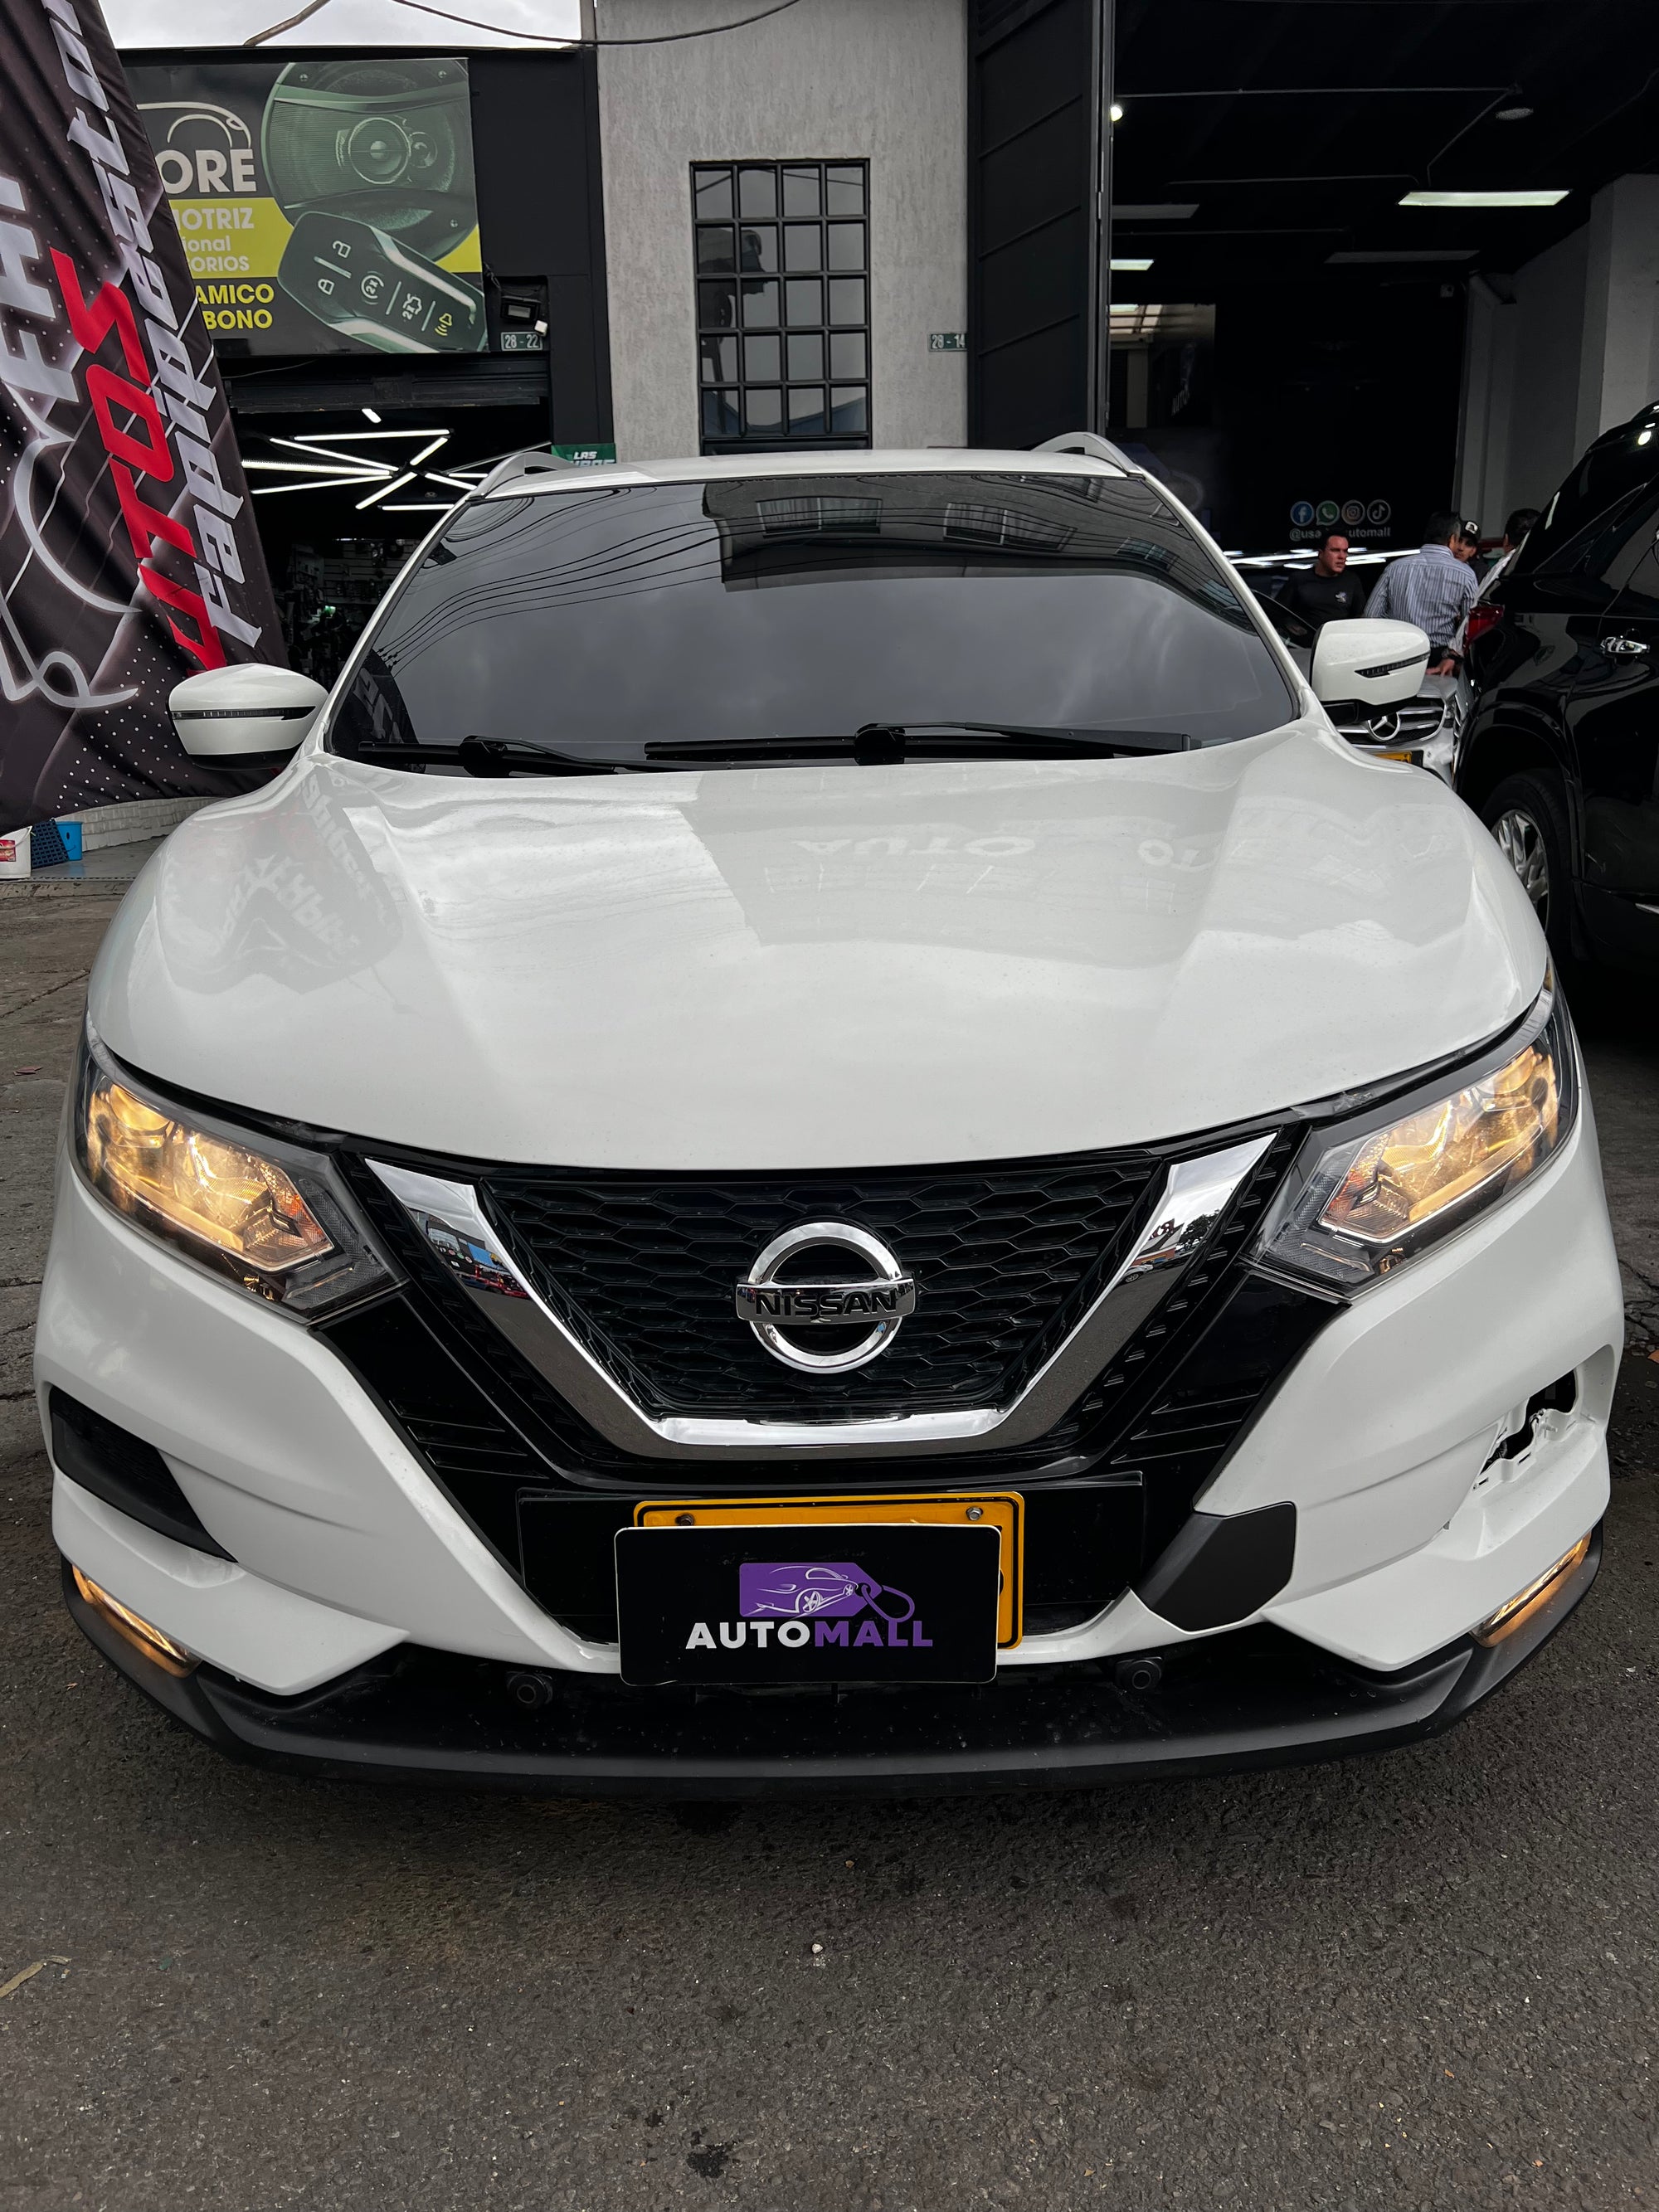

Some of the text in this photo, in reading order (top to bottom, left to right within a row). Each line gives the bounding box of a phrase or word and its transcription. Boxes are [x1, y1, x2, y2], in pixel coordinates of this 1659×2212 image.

[50, 247, 228, 677] UTOS
[755, 1291, 898, 1317] NISSAN
[685, 1619, 934, 1650] AUTOMALL
